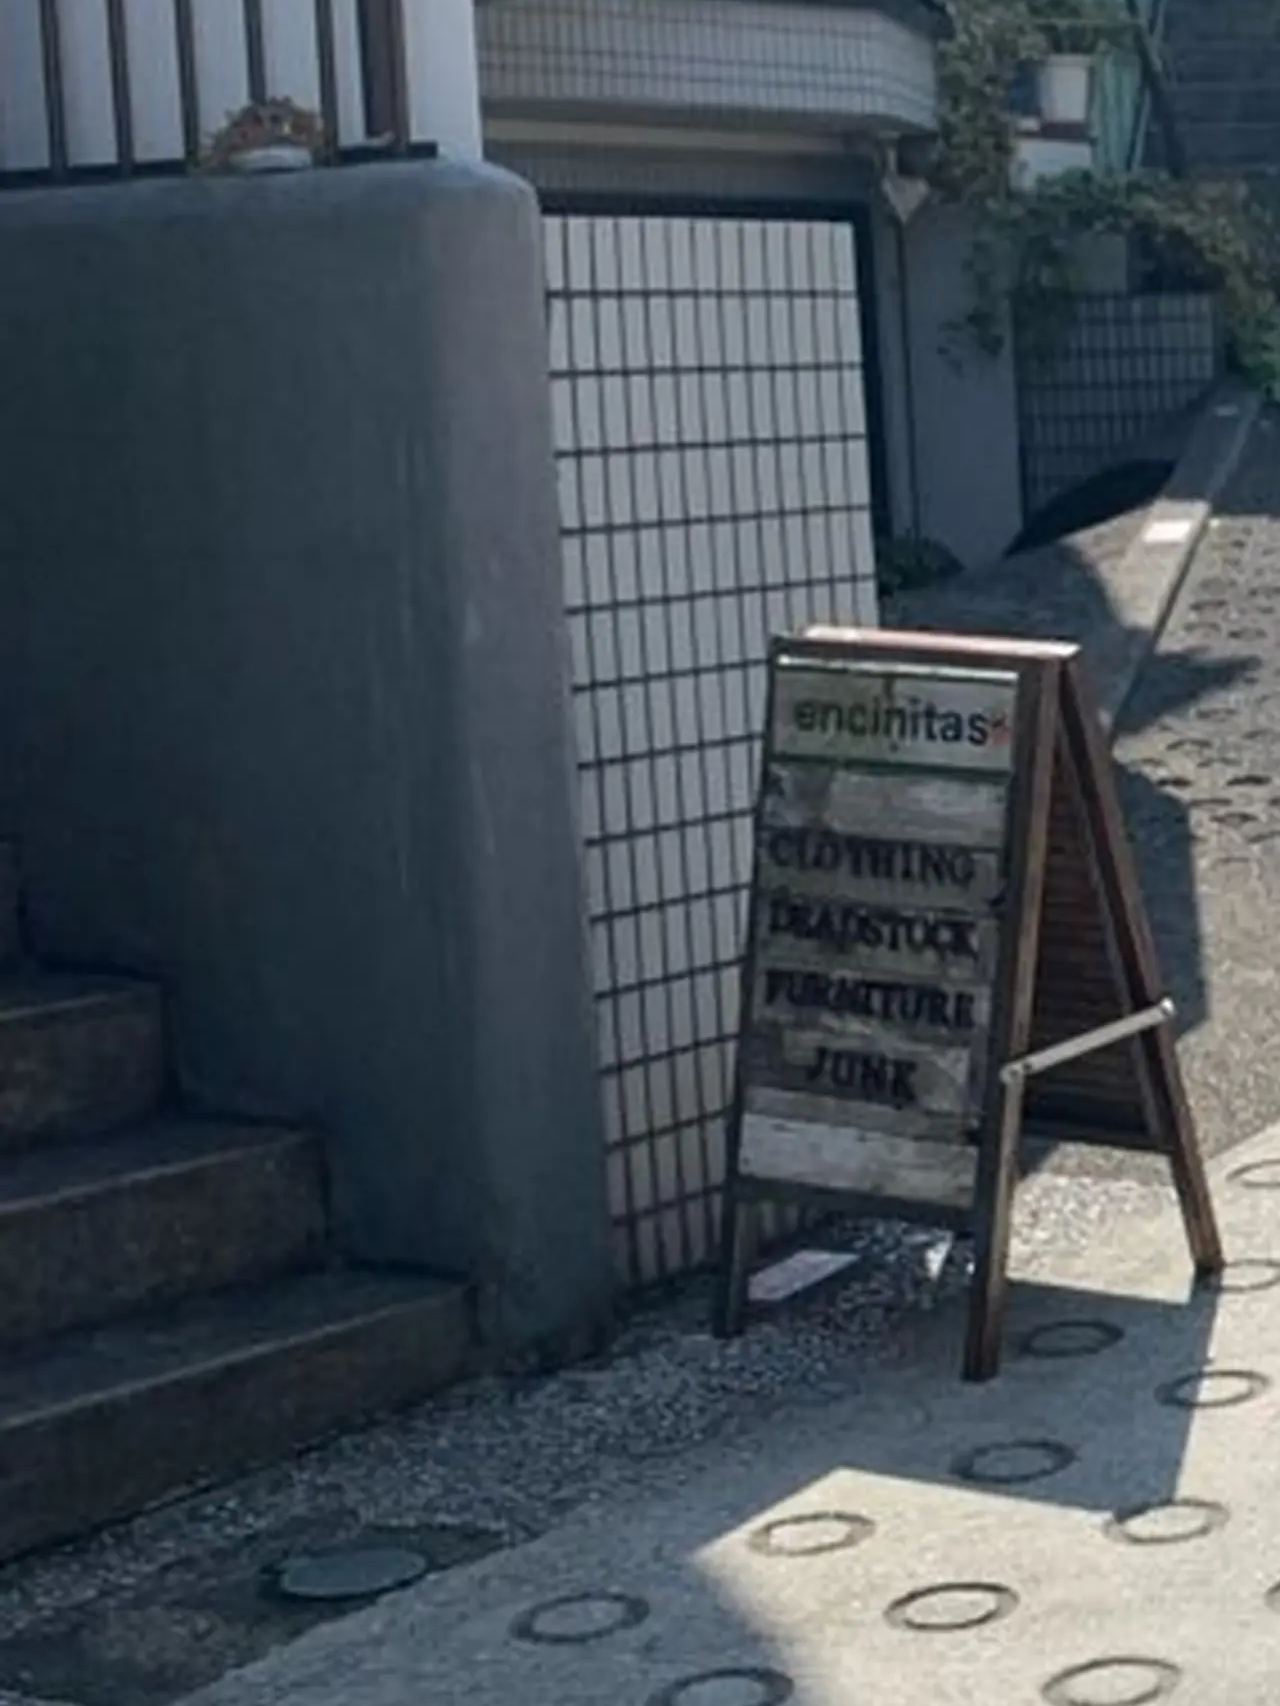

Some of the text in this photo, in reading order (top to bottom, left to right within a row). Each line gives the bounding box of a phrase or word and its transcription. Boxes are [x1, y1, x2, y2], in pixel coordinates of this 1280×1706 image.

[794, 695, 989, 747] encinitas
[768, 831, 976, 888] CLOTHING
[769, 897, 978, 960] DEADSTOCK
[765, 970, 976, 1029] FURNITURE
[806, 1046, 918, 1110] JUNK
